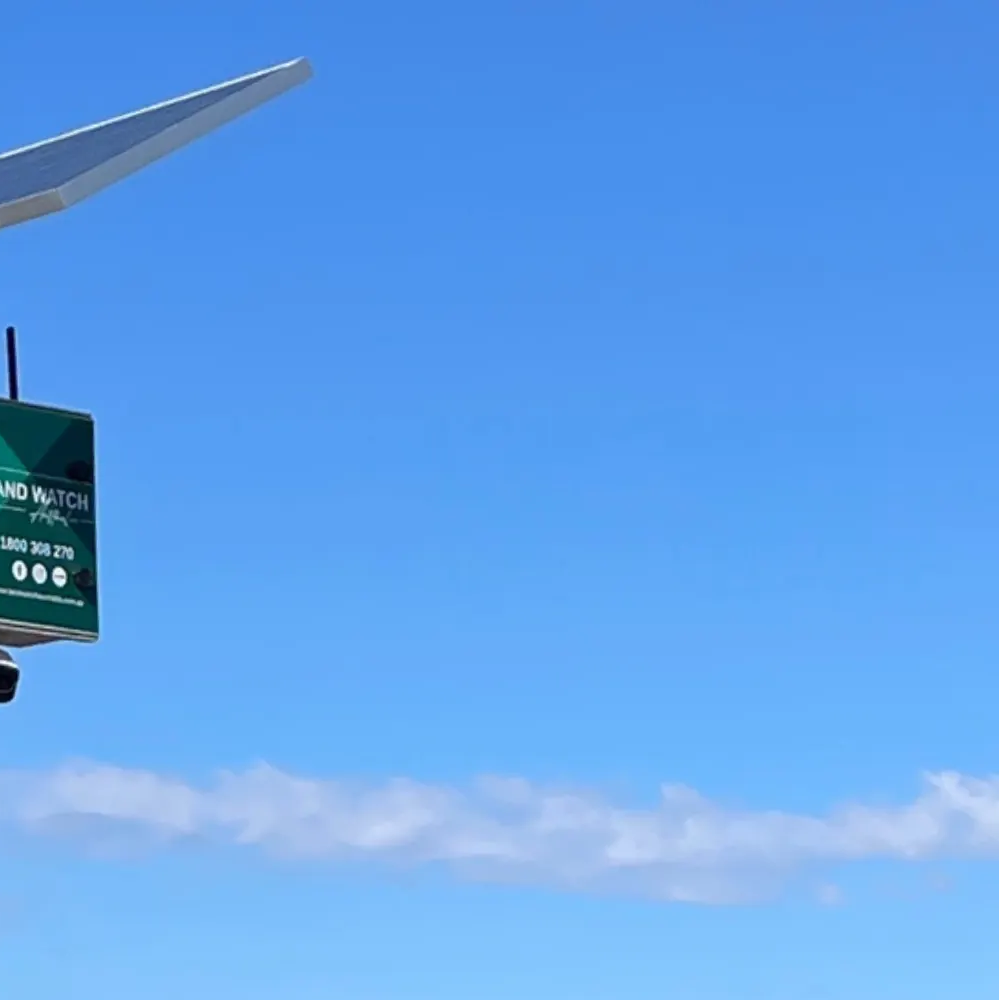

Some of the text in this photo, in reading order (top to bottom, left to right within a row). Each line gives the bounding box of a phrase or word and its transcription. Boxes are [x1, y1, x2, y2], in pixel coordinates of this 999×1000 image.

[31, 484, 89, 512] WATCH
[0, 535, 28, 554] 1800
[53, 544, 75, 561] 270
